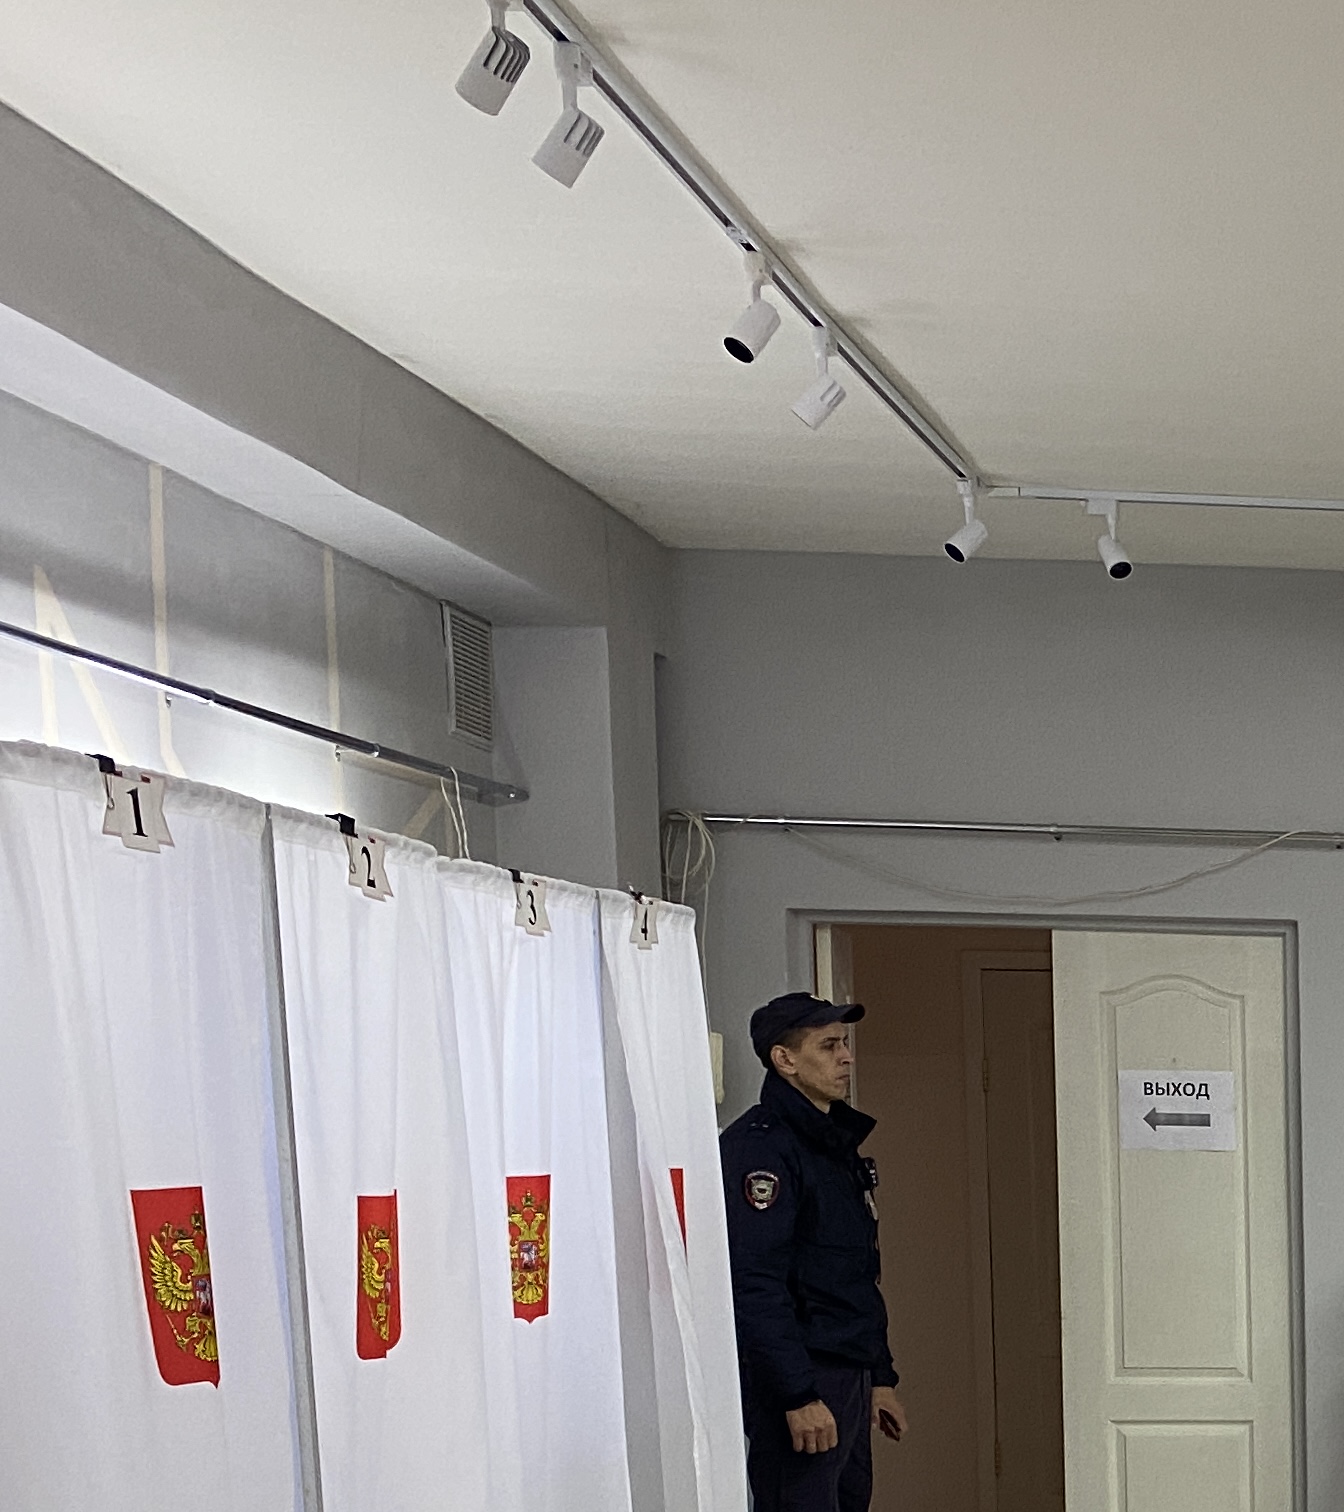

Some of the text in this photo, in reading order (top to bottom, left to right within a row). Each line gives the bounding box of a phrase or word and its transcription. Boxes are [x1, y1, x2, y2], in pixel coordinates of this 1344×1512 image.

[127, 786, 149, 838] 1
[360, 845, 377, 889] 2
[526, 889, 538, 926] 3
[640, 907, 649, 941] 4
[1143, 1081, 1210, 1100] ВЫХОД
